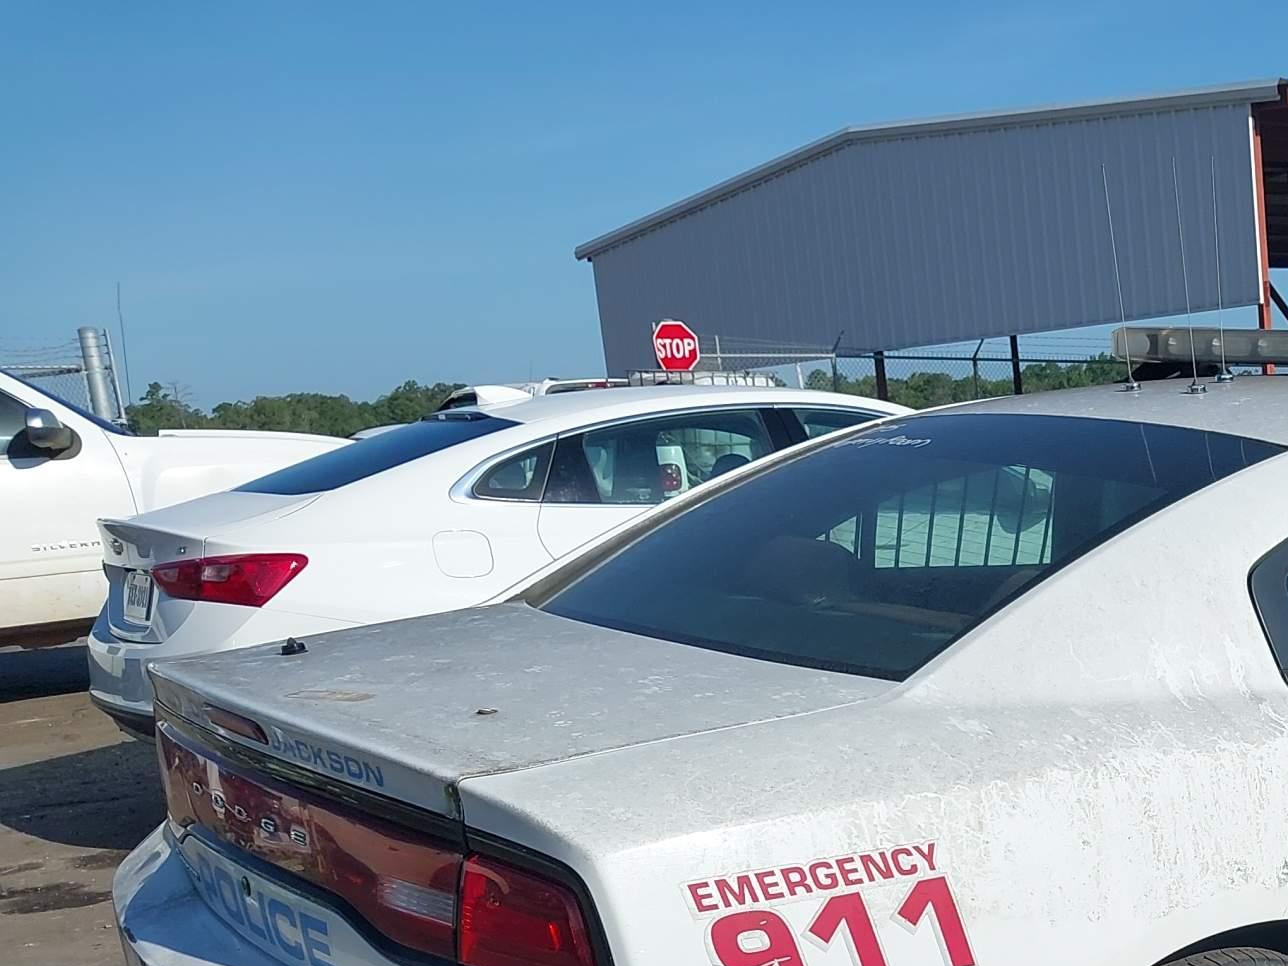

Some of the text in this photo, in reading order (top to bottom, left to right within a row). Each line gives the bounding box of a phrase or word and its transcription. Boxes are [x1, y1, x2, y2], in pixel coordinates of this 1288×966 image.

[656, 338, 695, 359] STOP
[271, 728, 384, 788] JACKSON
[193, 782, 307, 847] DODGE
[687, 842, 938, 913] EMERGENCY
